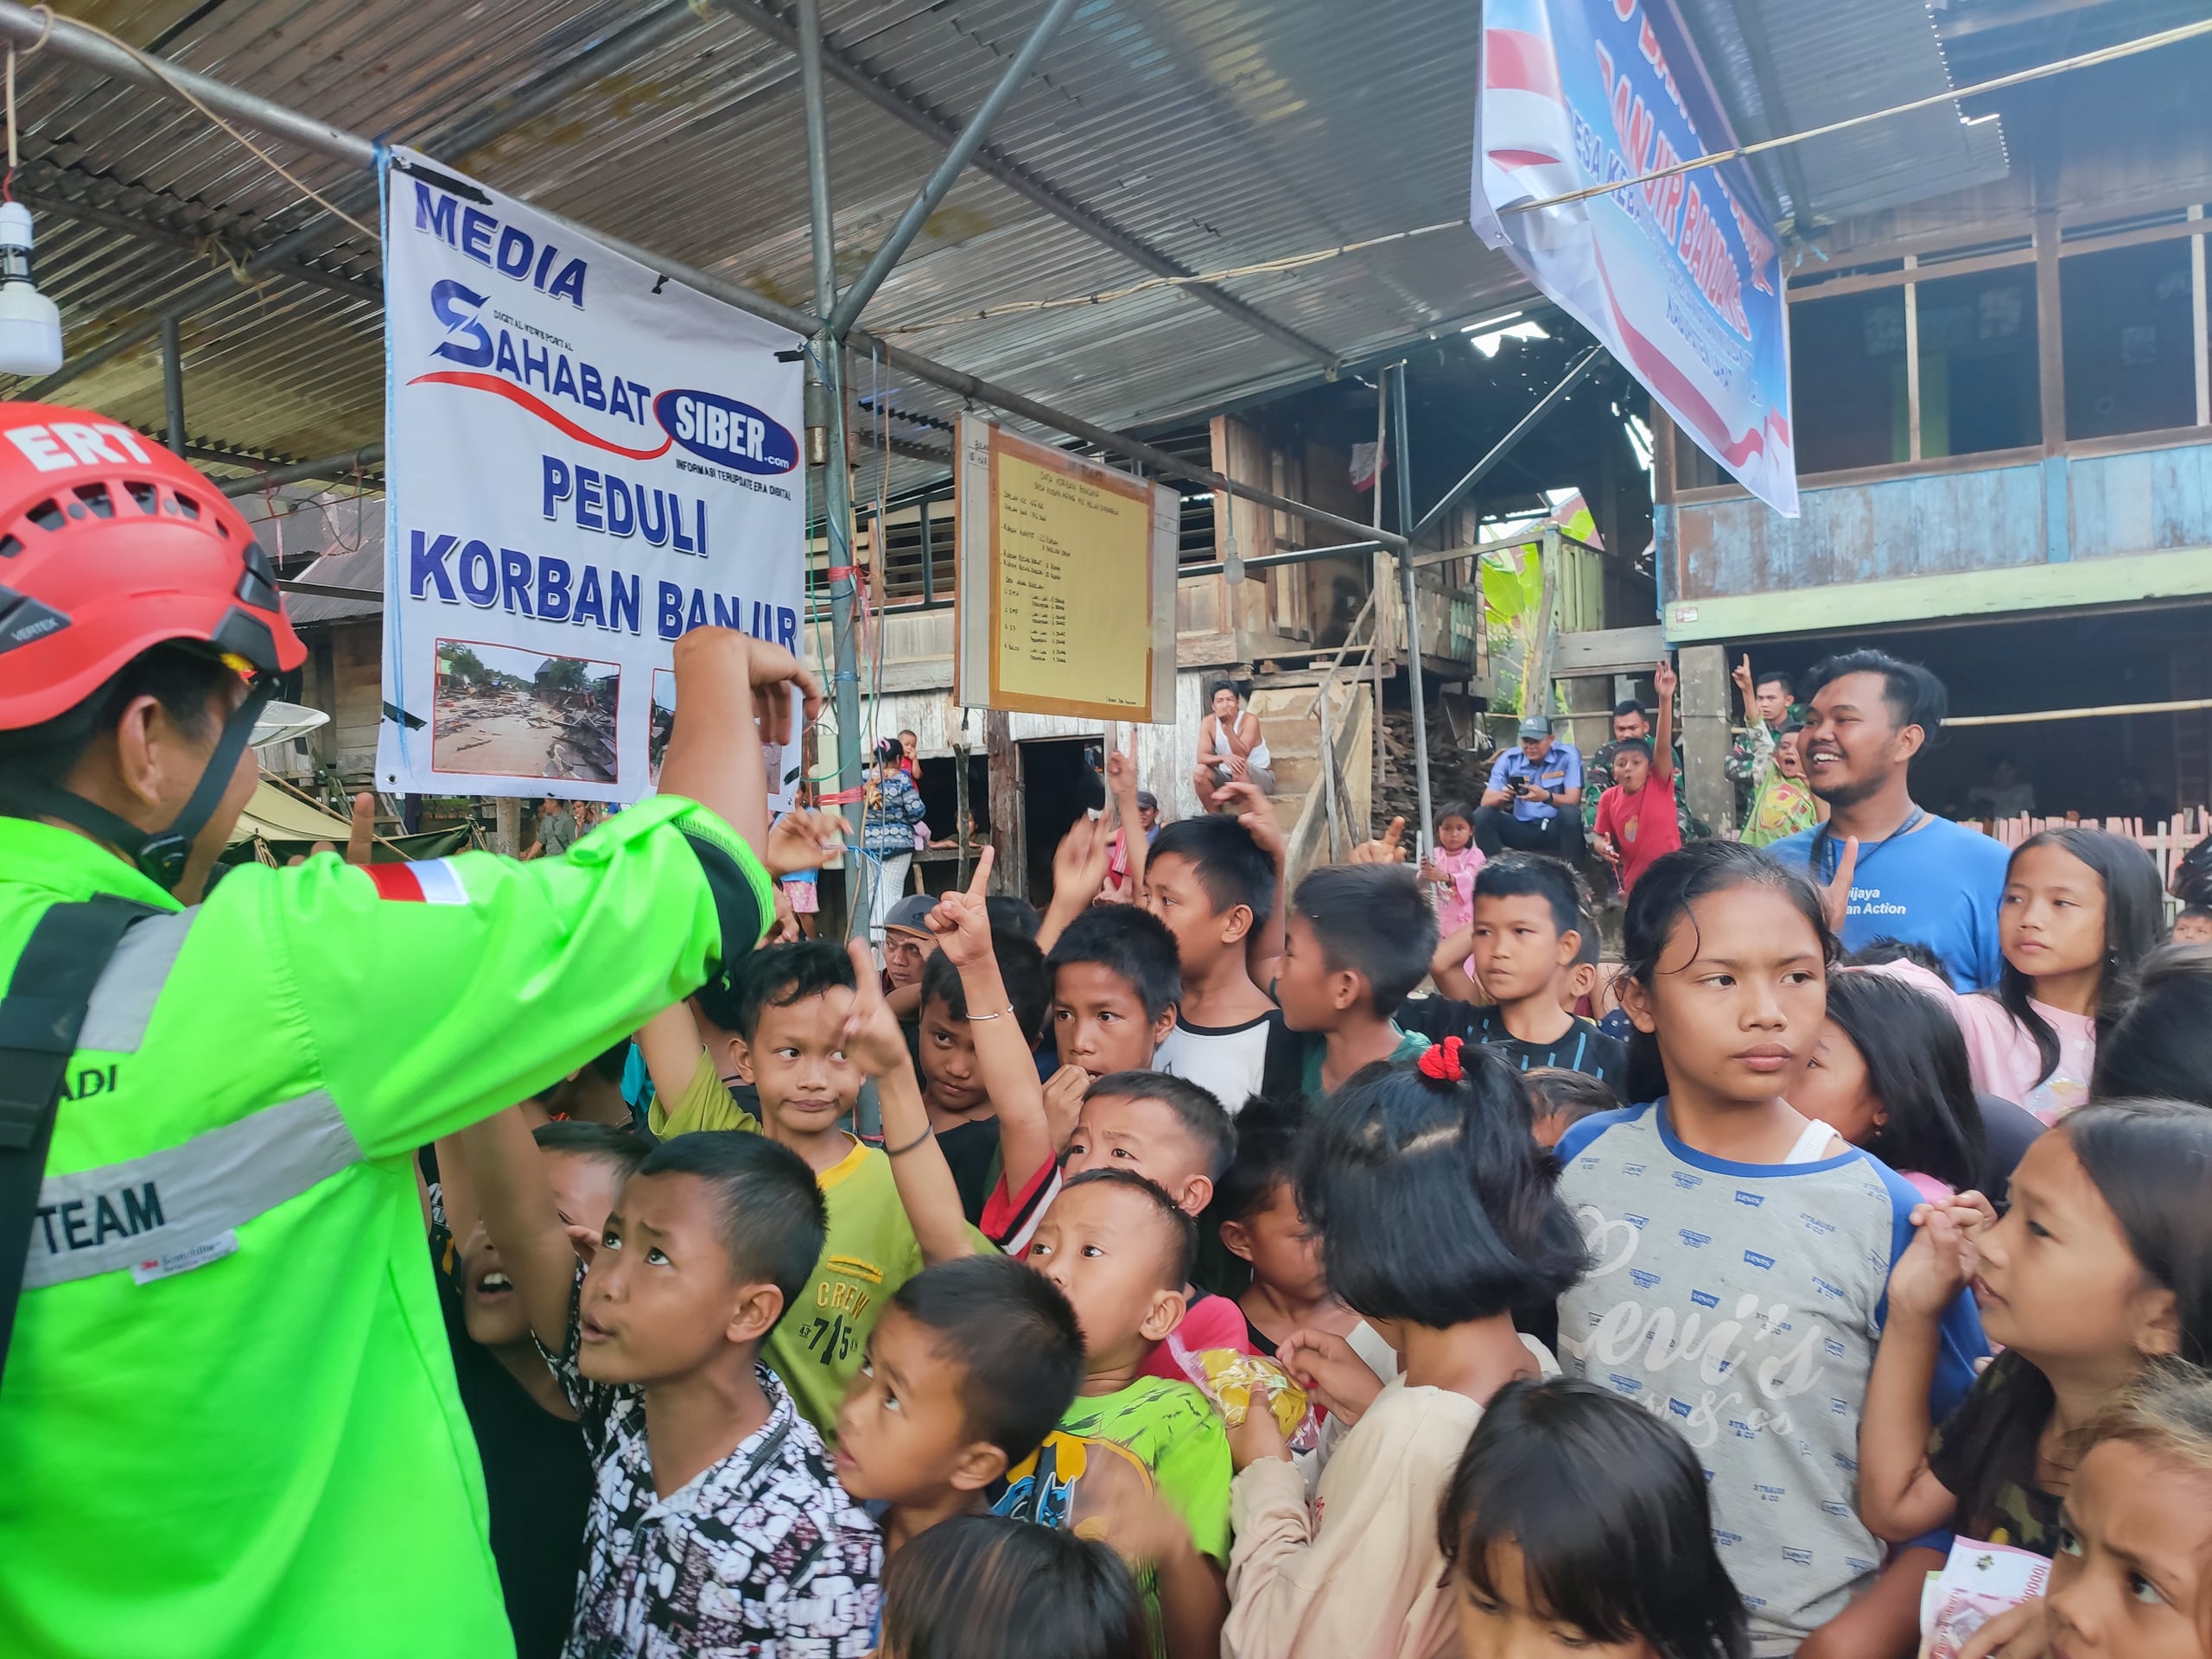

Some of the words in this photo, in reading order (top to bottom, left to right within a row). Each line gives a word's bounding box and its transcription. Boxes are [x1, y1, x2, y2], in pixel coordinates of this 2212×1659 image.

[414, 181, 587, 309] MEDIA
[428, 279, 651, 427] SAHABAT
[4, 423, 152, 472] ERT
[675, 458, 716, 478] INFORMASI
[716, 469, 753, 491] TERUPDATE
[753, 480, 768, 494] ERA
[542, 454, 708, 556] PEDULI
[410, 530, 641, 635] KORBAN
[658, 580, 798, 660] BANJIR
[10, 617, 60, 642] VERTEX
[1863, 902, 1907, 916] Action
[35, 1181, 165, 1255] TEAM
[816, 1281, 870, 1321] CREW
